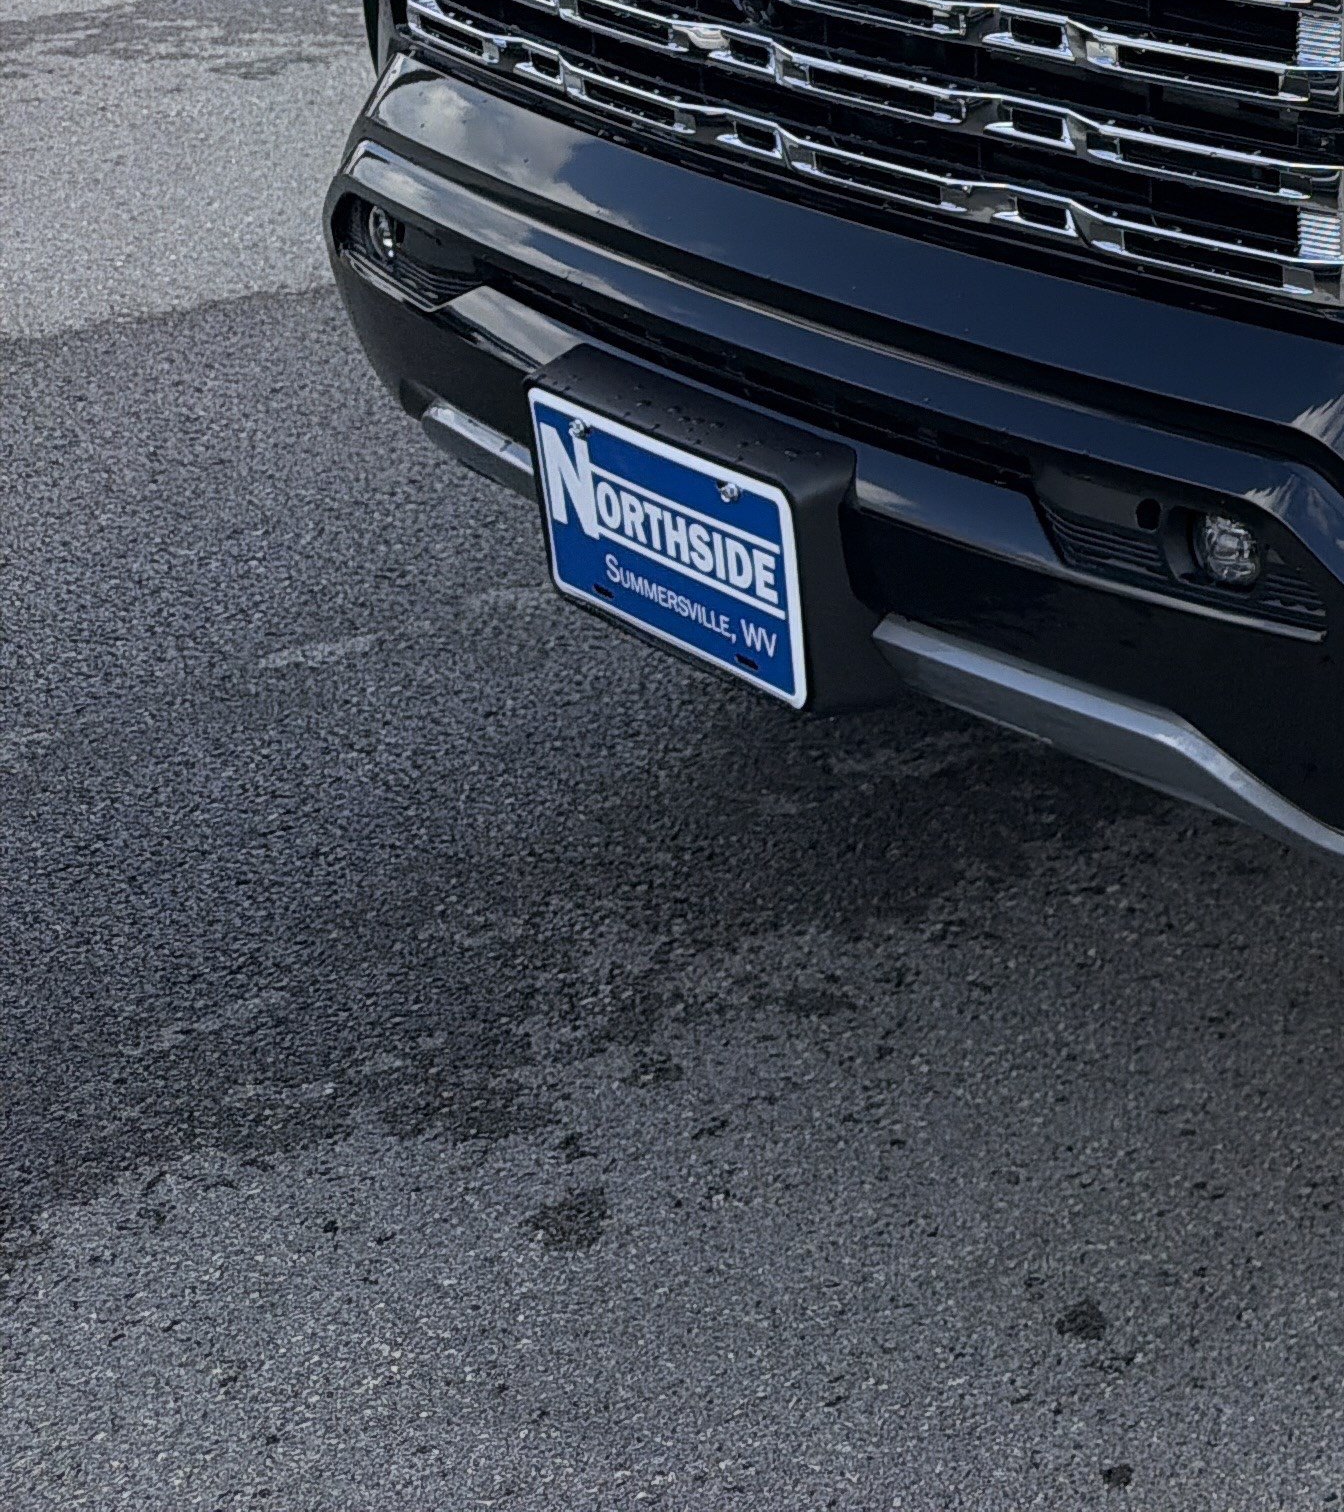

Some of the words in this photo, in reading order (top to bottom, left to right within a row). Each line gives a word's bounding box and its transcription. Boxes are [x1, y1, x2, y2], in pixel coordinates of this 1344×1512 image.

[539, 421, 780, 605] NORTHSIDE
[604, 553, 738, 644] SUMMERSVILLE,
[740, 618, 778, 658] WV
